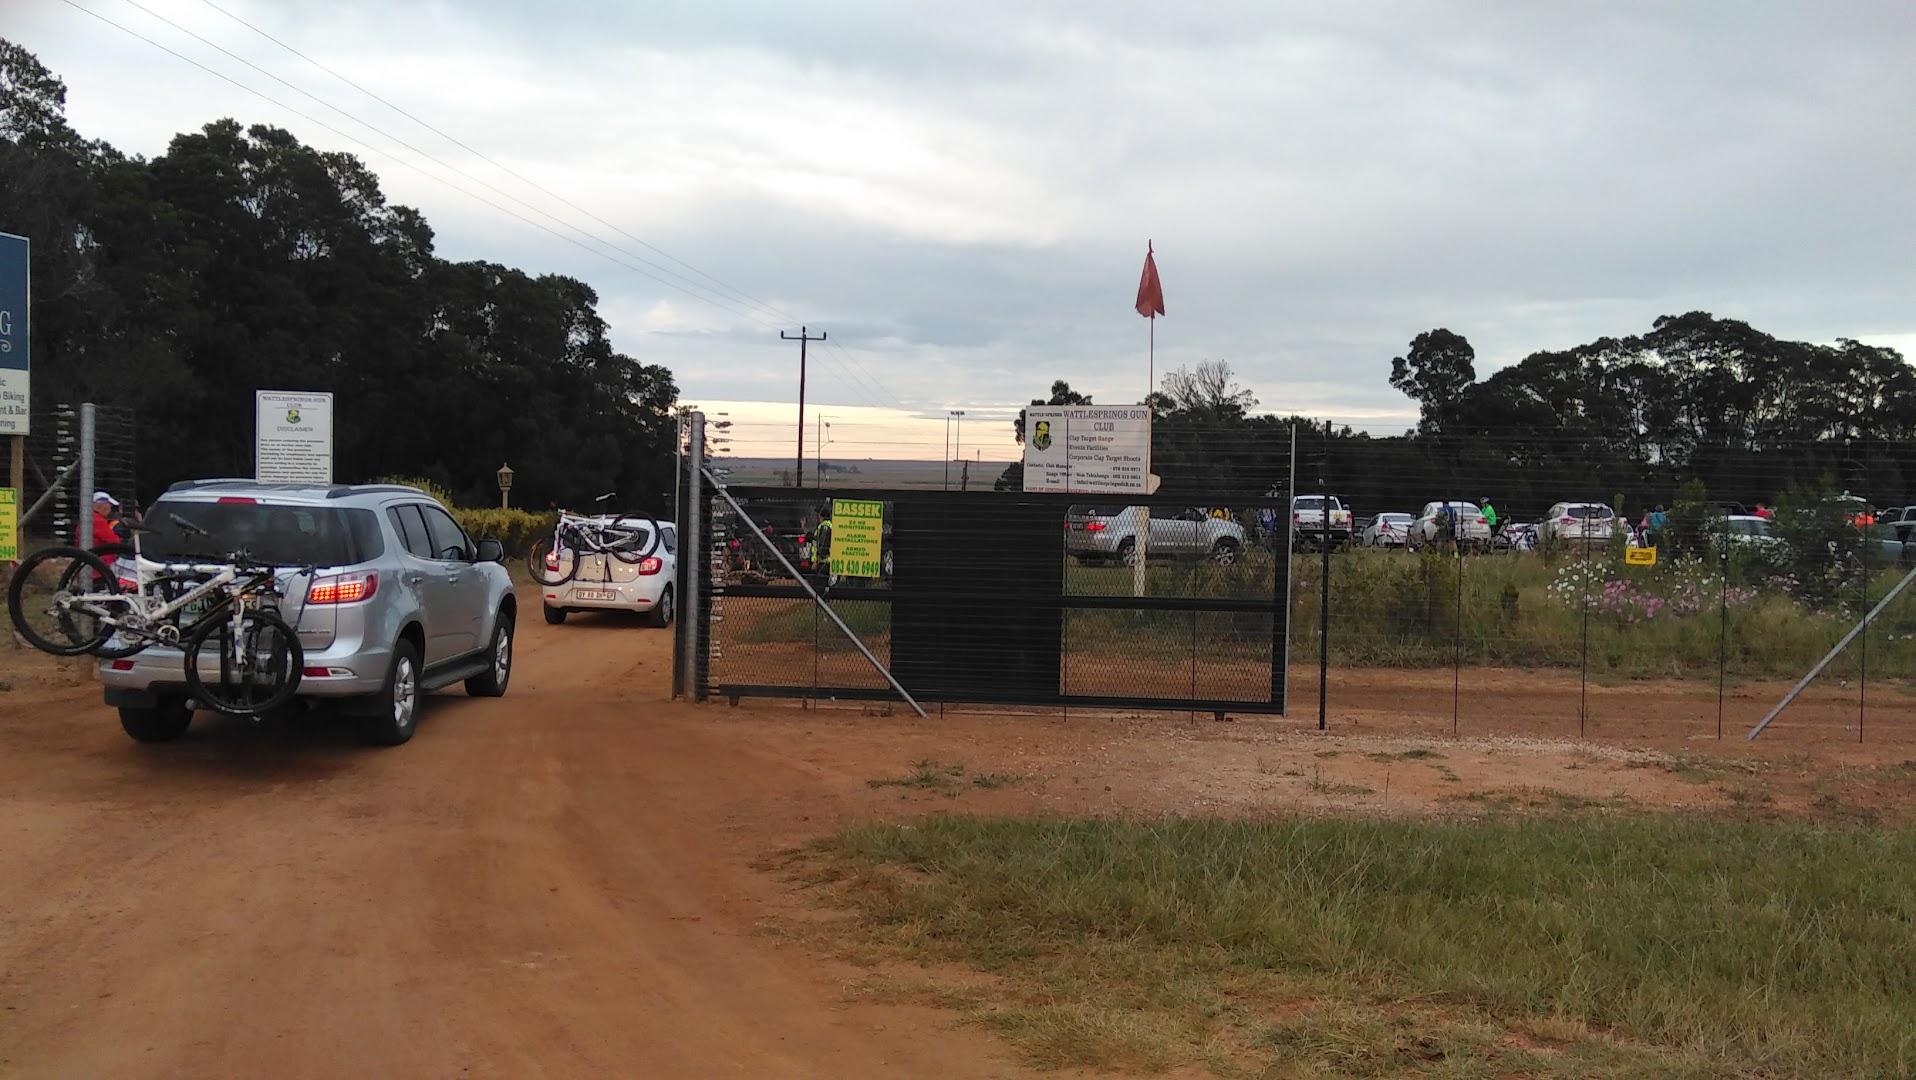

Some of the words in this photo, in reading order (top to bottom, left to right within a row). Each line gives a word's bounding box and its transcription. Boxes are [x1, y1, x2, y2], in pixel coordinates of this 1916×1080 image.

[3, 391, 24, 403] Biking
[1063, 410, 1128, 419] WATTLESPRINGS
[1130, 410, 1148, 419] GUN
[1094, 422, 1115, 431] CLUB
[1069, 435, 1080, 443] Clay
[1081, 435, 1097, 443] Target
[1069, 454, 1093, 462] Corporate
[834, 502, 881, 517] BASSEK
[831, 560, 844, 574] 083
